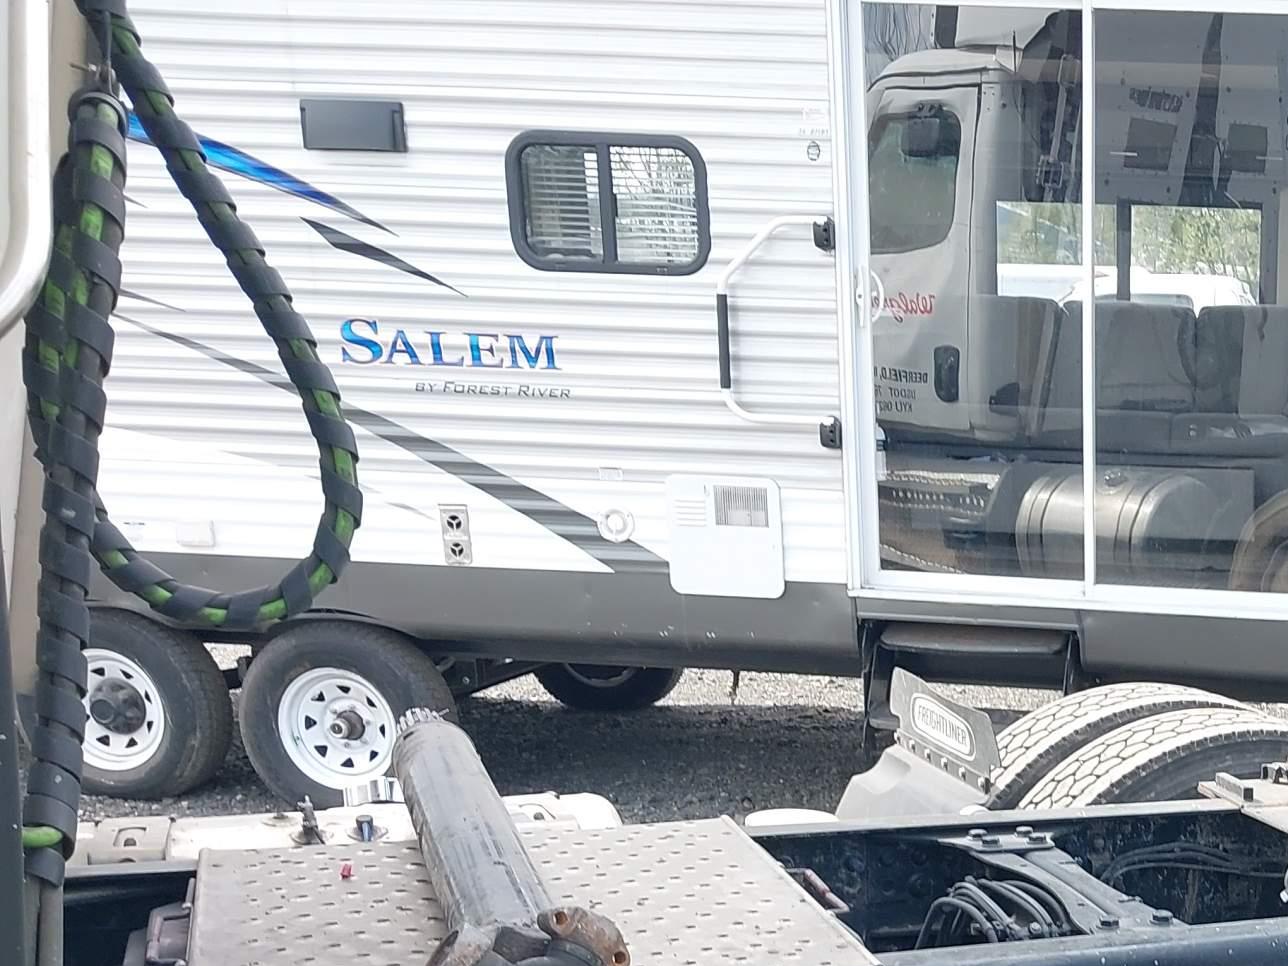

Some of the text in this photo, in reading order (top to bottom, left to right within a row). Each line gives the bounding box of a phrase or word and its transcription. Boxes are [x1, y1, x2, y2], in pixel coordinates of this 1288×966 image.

[340, 318, 562, 370] SALEM
[415, 381, 571, 399] BY FOREST RIVER
[919, 705, 969, 746] FREIGHTLINER
